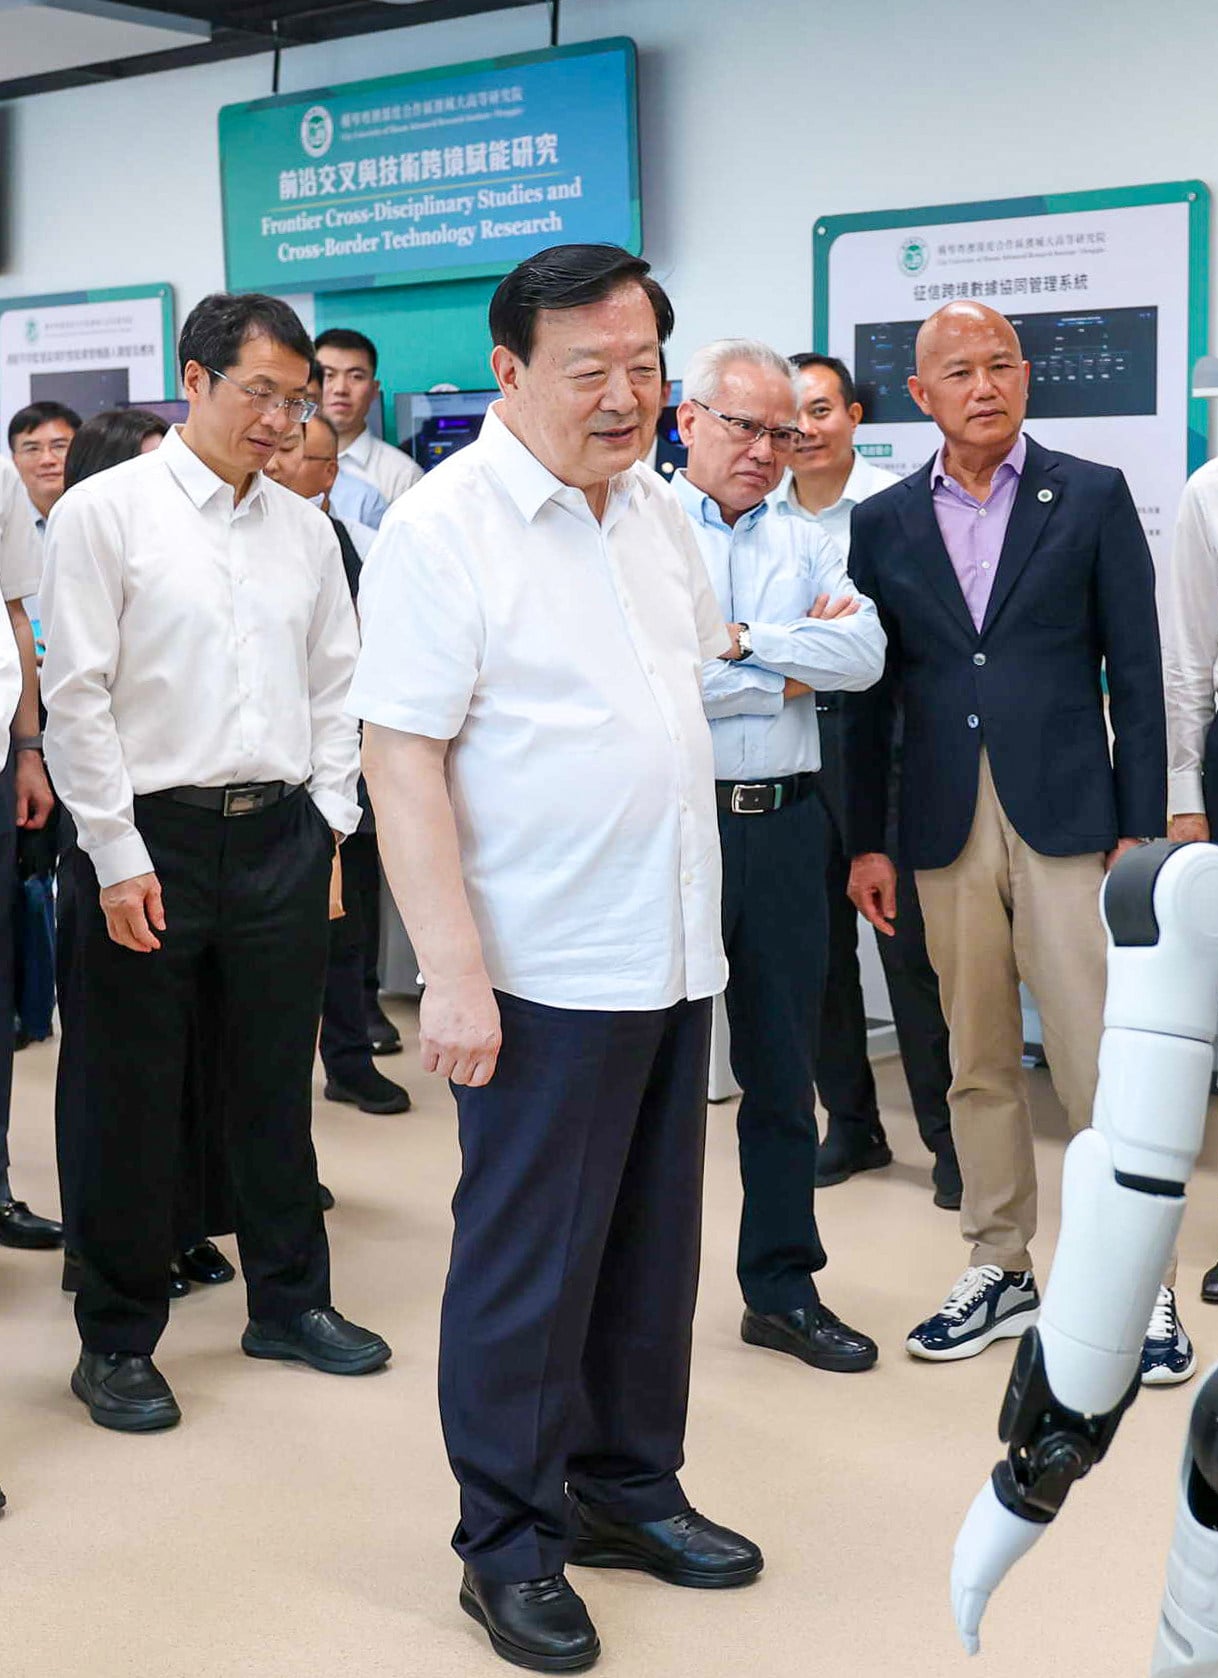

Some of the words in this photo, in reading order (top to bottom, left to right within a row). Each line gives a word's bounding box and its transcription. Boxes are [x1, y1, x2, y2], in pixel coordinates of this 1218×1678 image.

[278, 133, 558, 200] 前沿交叉與技術跨境賦能研究
[261, 211, 323, 236] Frontier
[325, 191, 475, 228] Cross-Disciplinary
[477, 182, 543, 210] Studies
[547, 176, 583, 199] and
[277, 233, 380, 263] Cross-Border
[382, 222, 477, 248] Technology
[481, 211, 563, 240] Research
[913, 273, 1089, 301] 征信跨境數據協同管理系統
